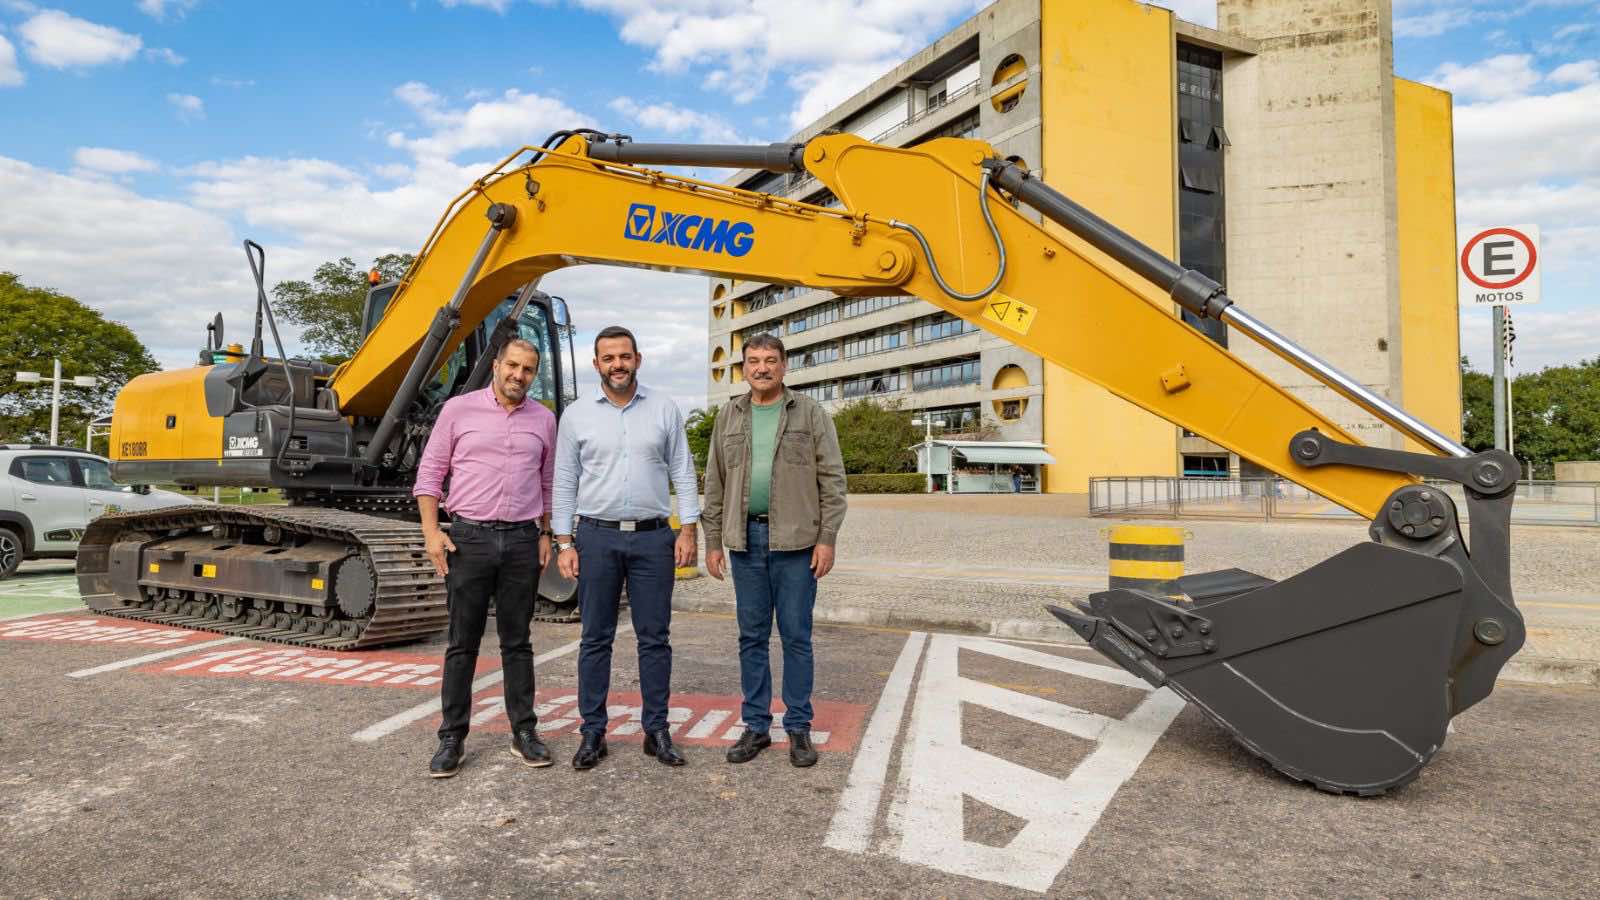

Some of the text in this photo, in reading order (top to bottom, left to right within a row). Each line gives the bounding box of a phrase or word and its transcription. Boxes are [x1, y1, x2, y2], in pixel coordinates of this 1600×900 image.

[649, 211, 754, 257] XCMG
[1483, 241, 1515, 276] E
[1475, 291, 1524, 303] MOTOS
[236, 436, 259, 449] XCMG
